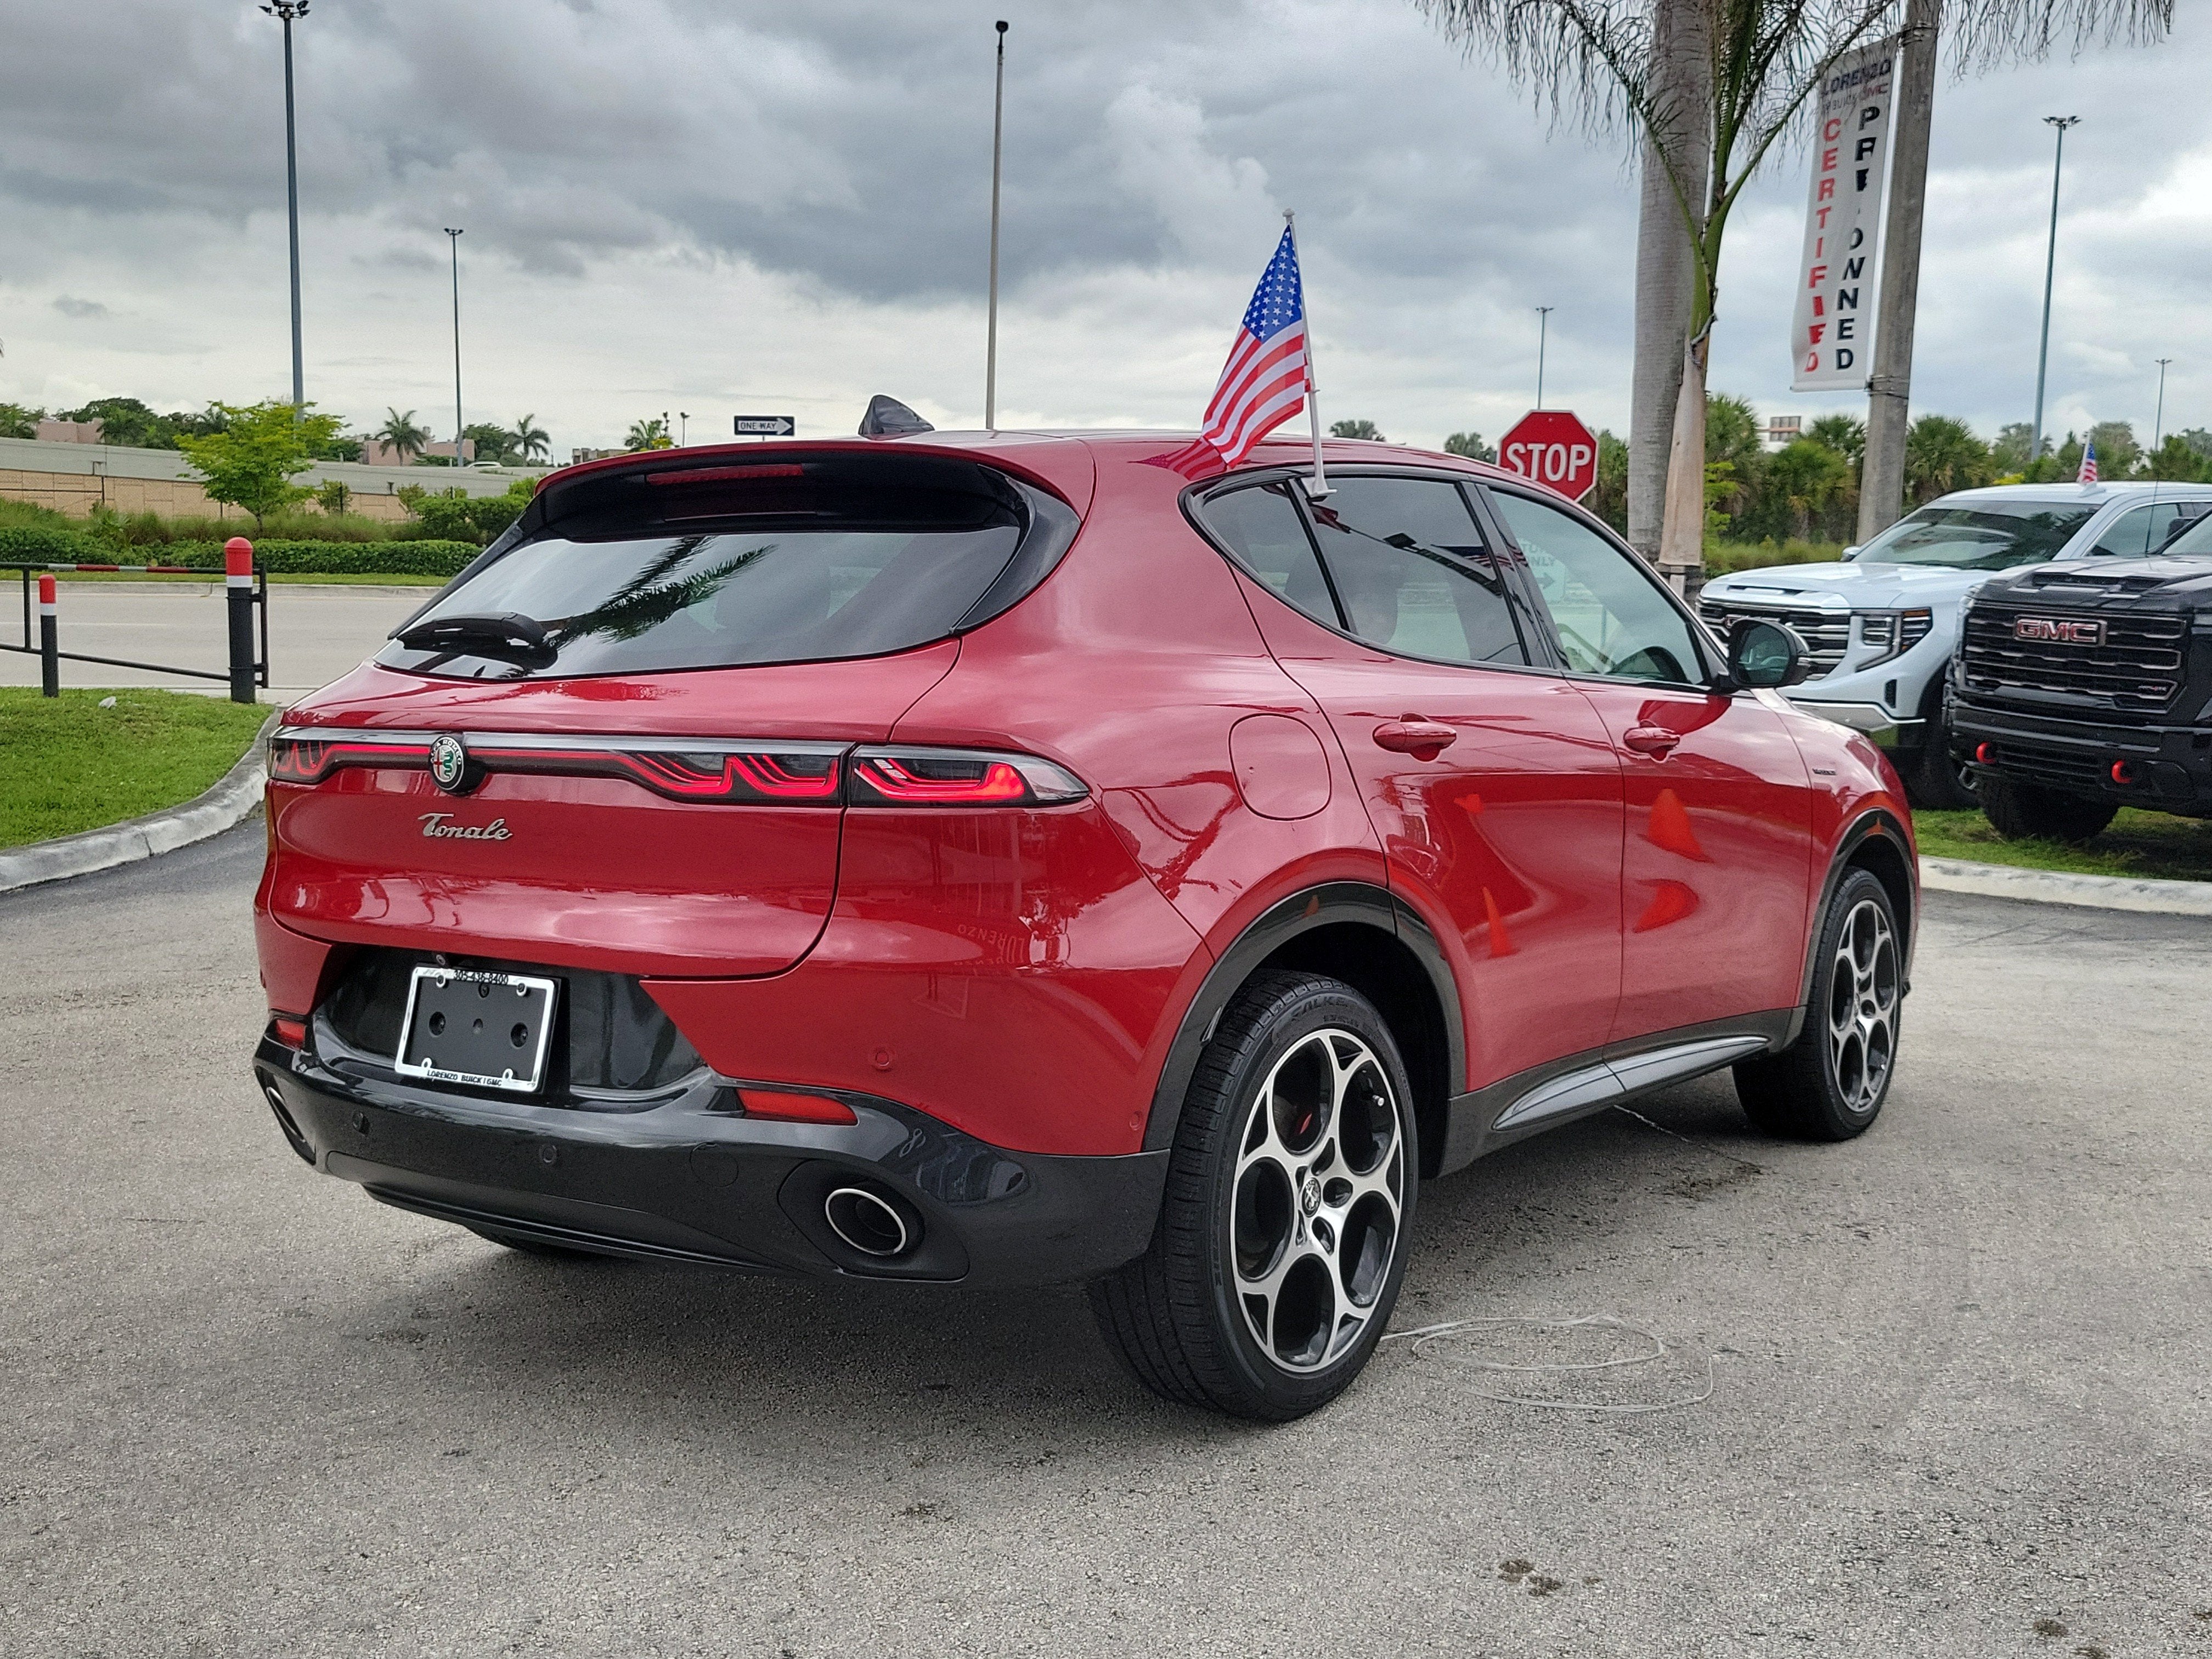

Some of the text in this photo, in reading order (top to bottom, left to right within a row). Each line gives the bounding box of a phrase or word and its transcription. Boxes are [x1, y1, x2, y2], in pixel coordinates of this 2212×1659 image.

[741, 422, 758, 430] ONE
[1506, 442, 1592, 482] STOP
[2017, 618, 2098, 643] GMC
[442, 739, 461, 765] ROMEO
[417, 812, 514, 840] Tonale
[427, 1069, 458, 1081] LORENZO
[461, 1074, 482, 1084] BUICK
[487, 1079, 503, 1087] GMC
